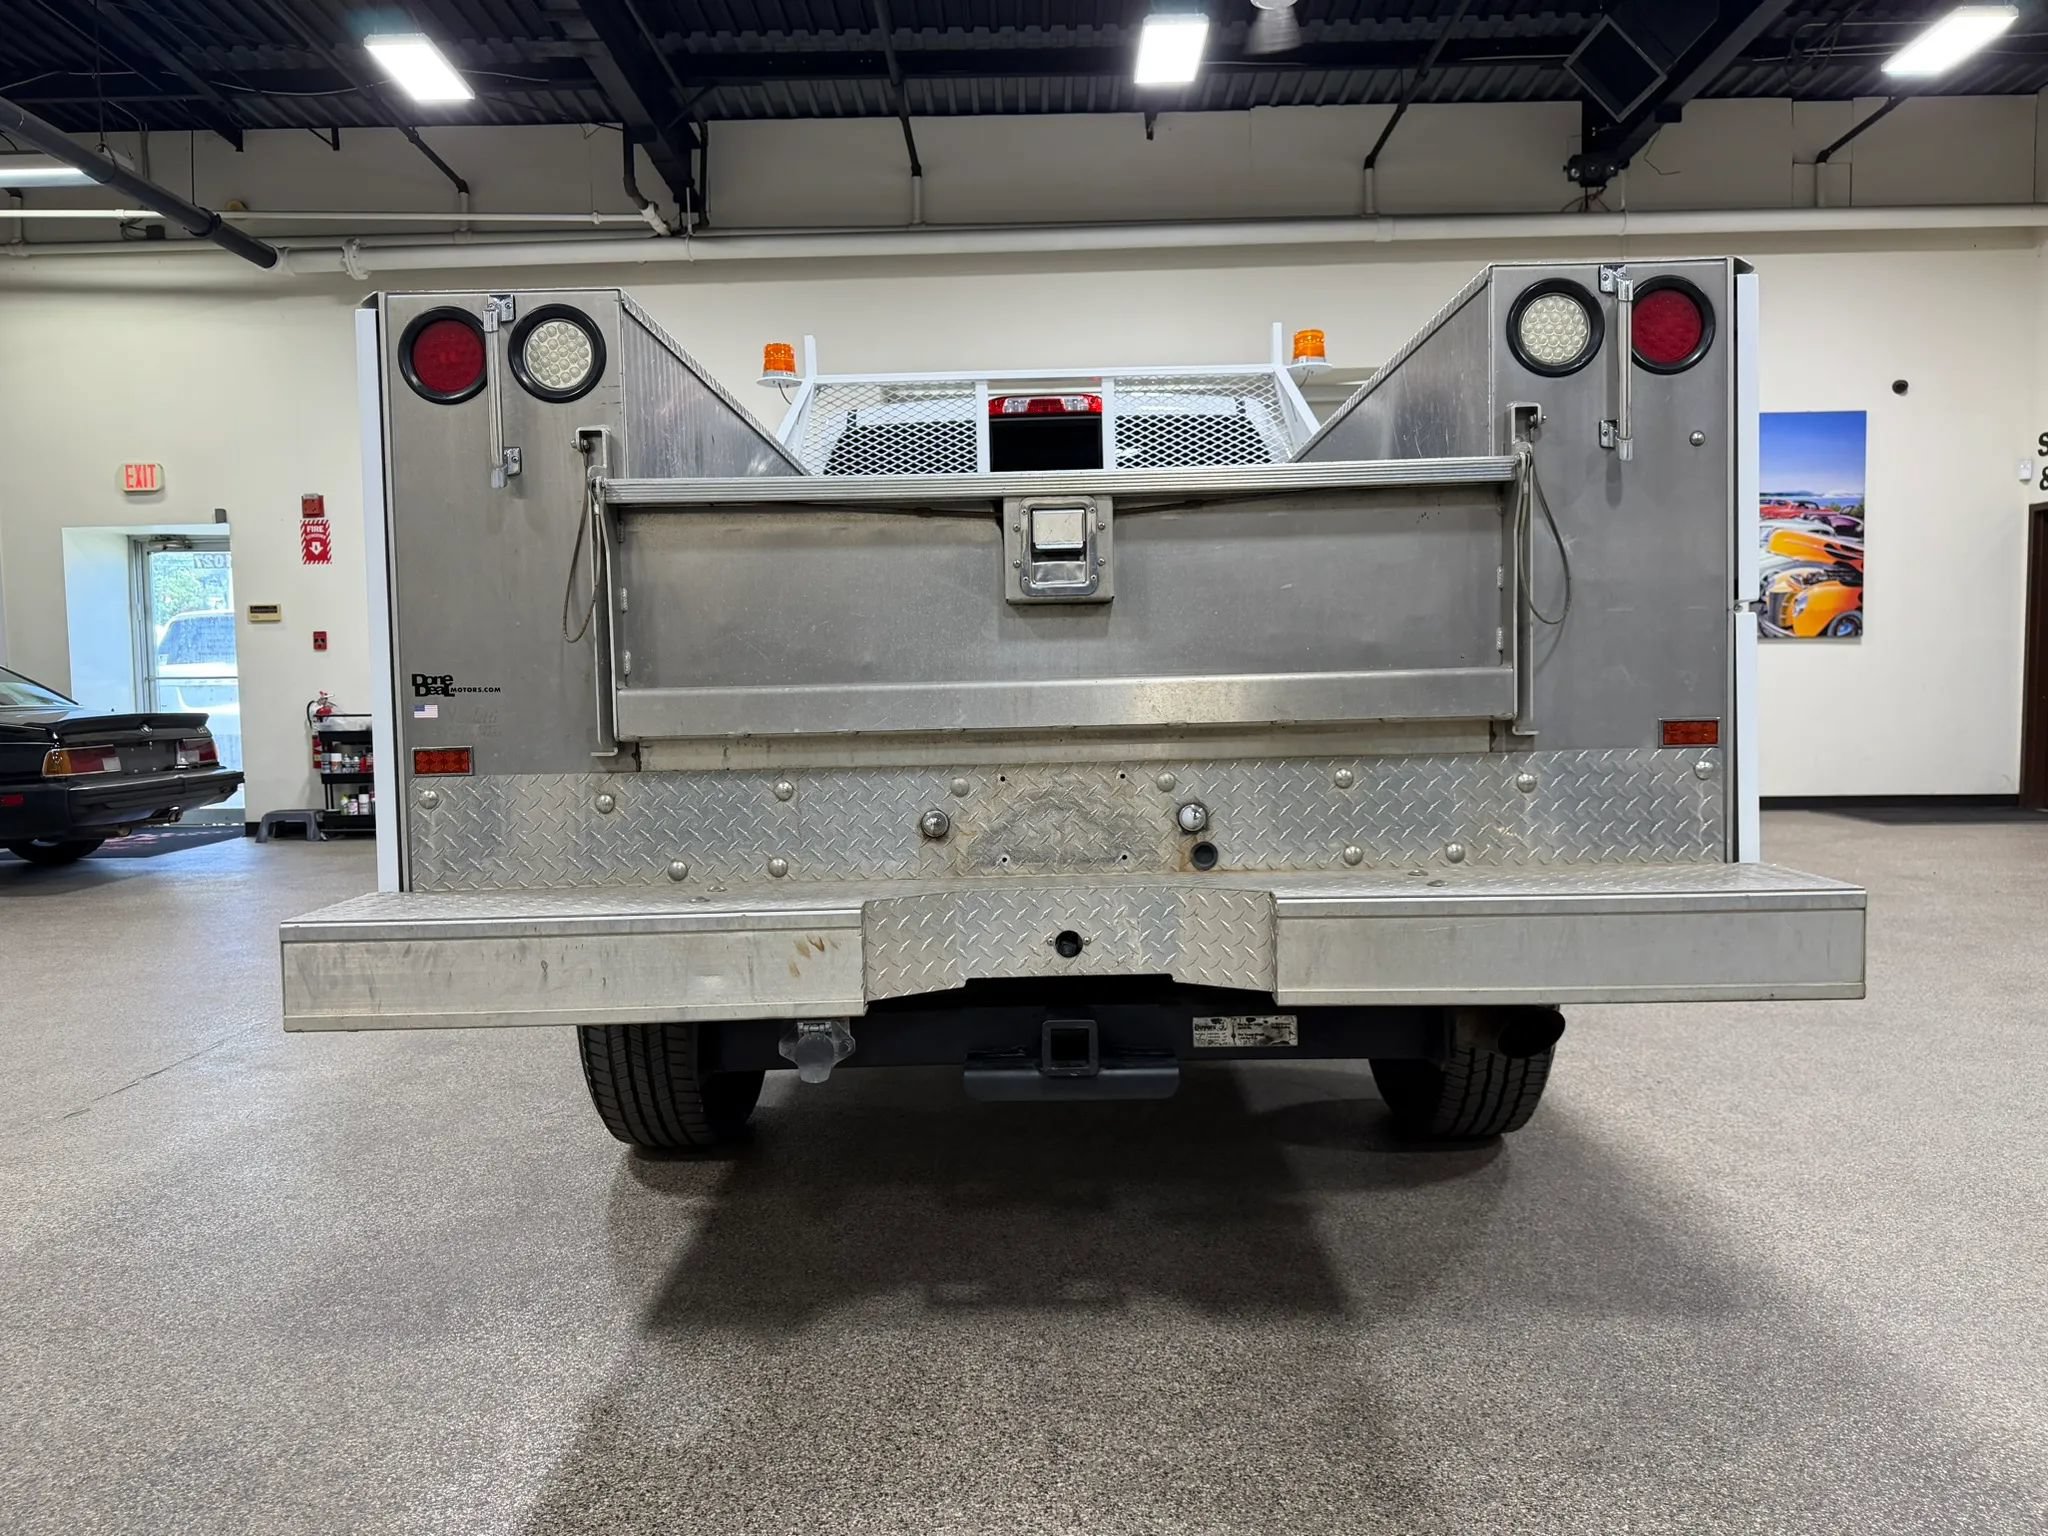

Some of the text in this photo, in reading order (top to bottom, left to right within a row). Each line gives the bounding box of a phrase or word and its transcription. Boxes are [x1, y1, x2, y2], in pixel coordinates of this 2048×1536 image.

[125, 463, 156, 488] EXIT
[306, 525, 324, 533] FIRE
[411, 673, 454, 687] Done
